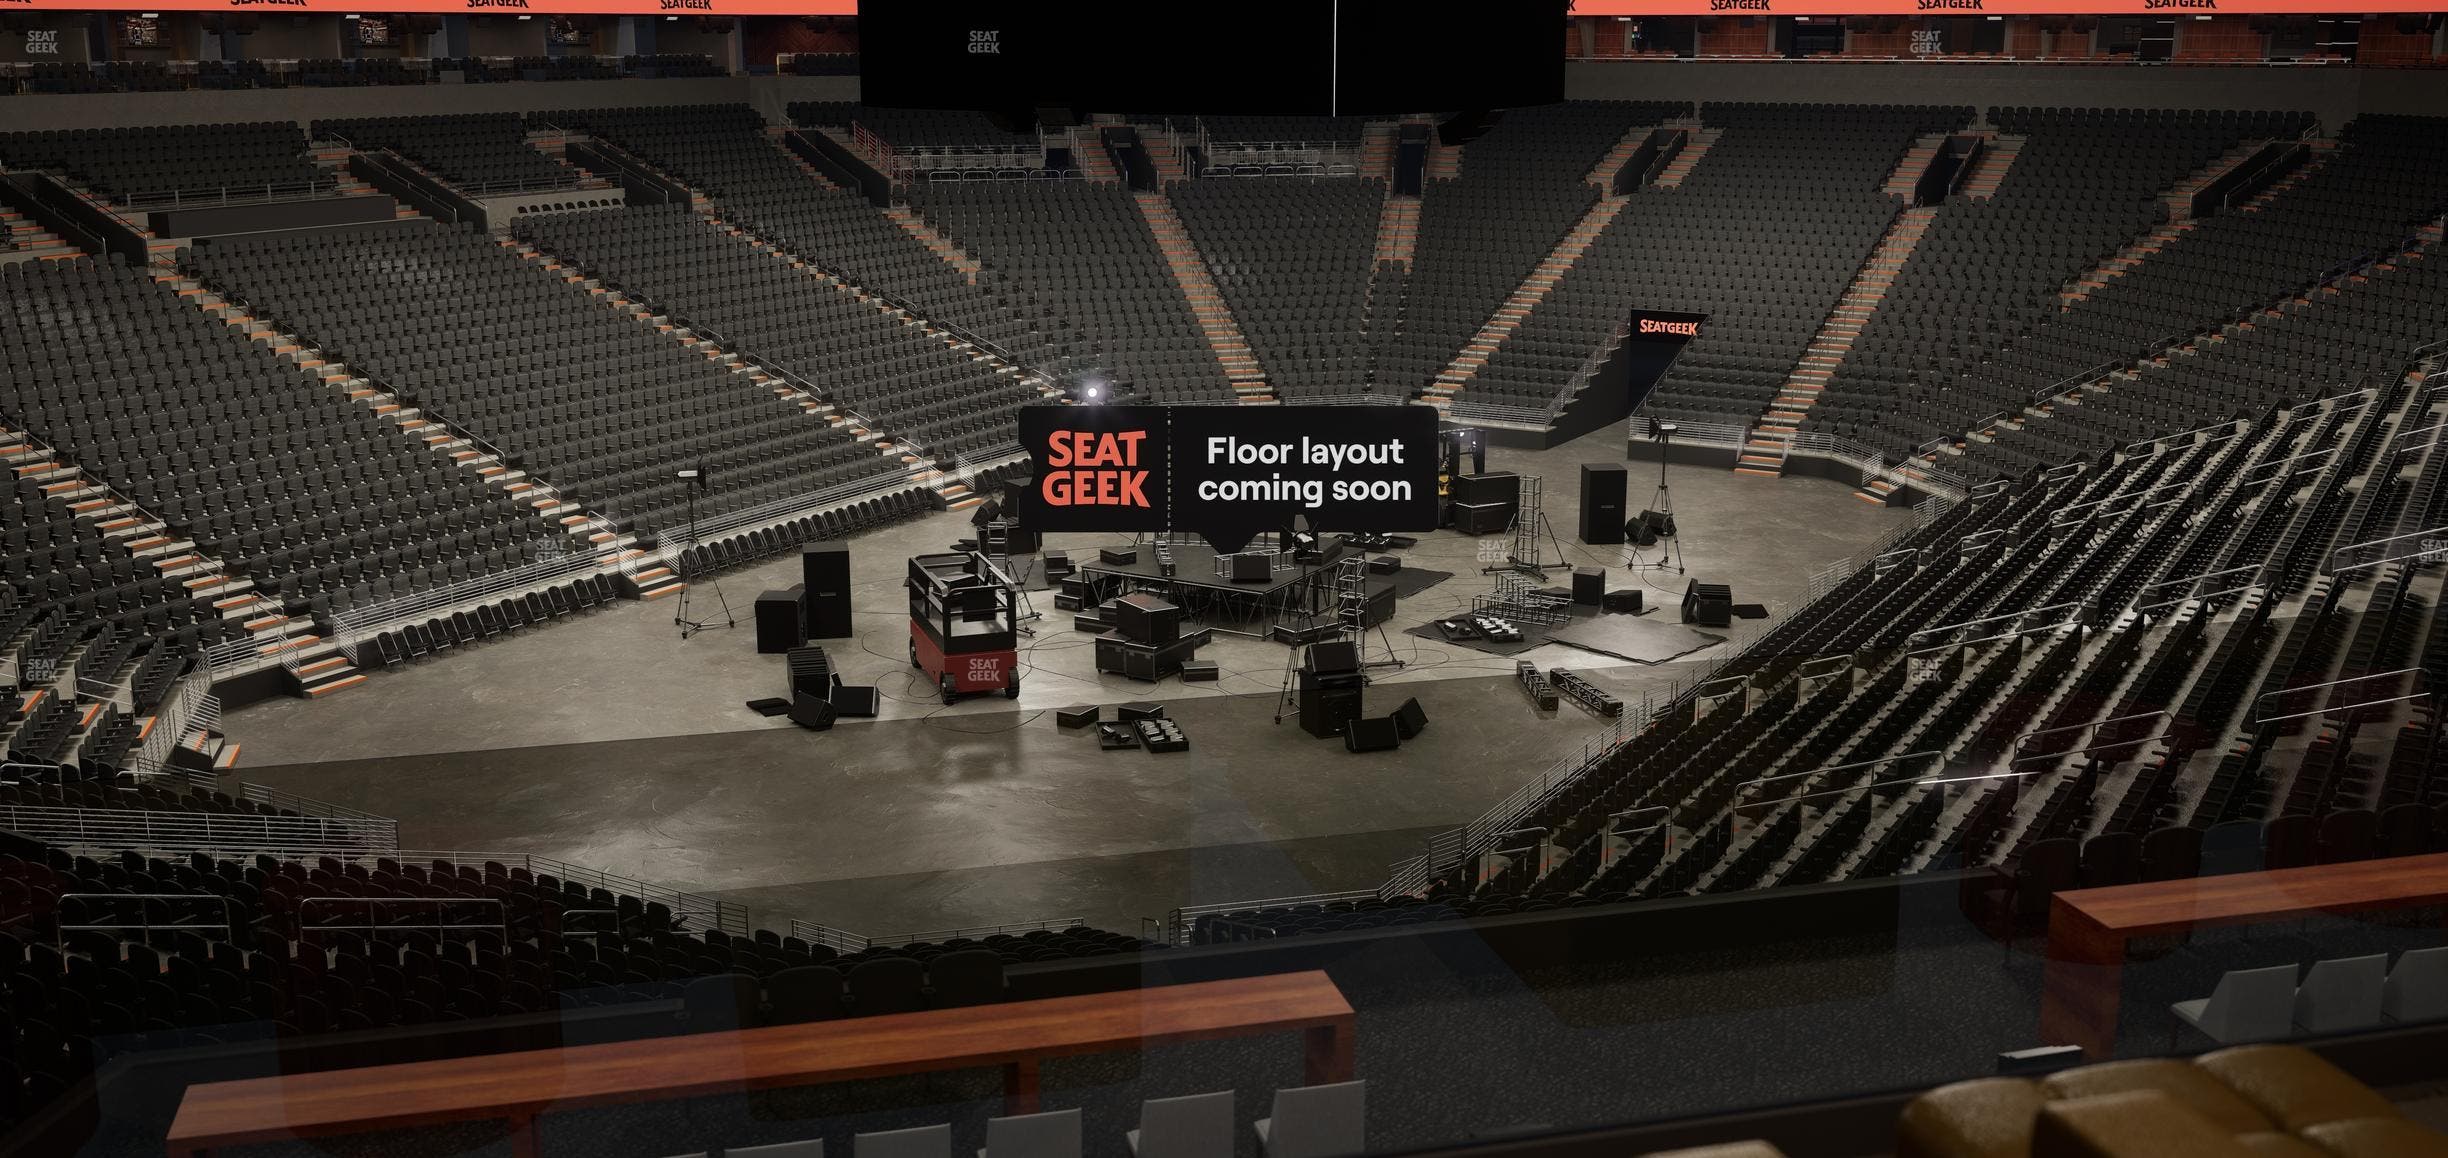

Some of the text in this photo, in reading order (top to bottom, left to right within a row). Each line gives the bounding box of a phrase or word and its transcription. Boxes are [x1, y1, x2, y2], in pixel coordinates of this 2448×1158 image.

[1710, 0, 1770, 10] SEATGEEK
[1639, 318, 1699, 336] SEATGEEK
[1048, 430, 1147, 467] SEAT
[1207, 436, 1405, 472] Floor layout
[1042, 470, 1151, 508] GEEK
[1198, 472, 1412, 508] coming soon
